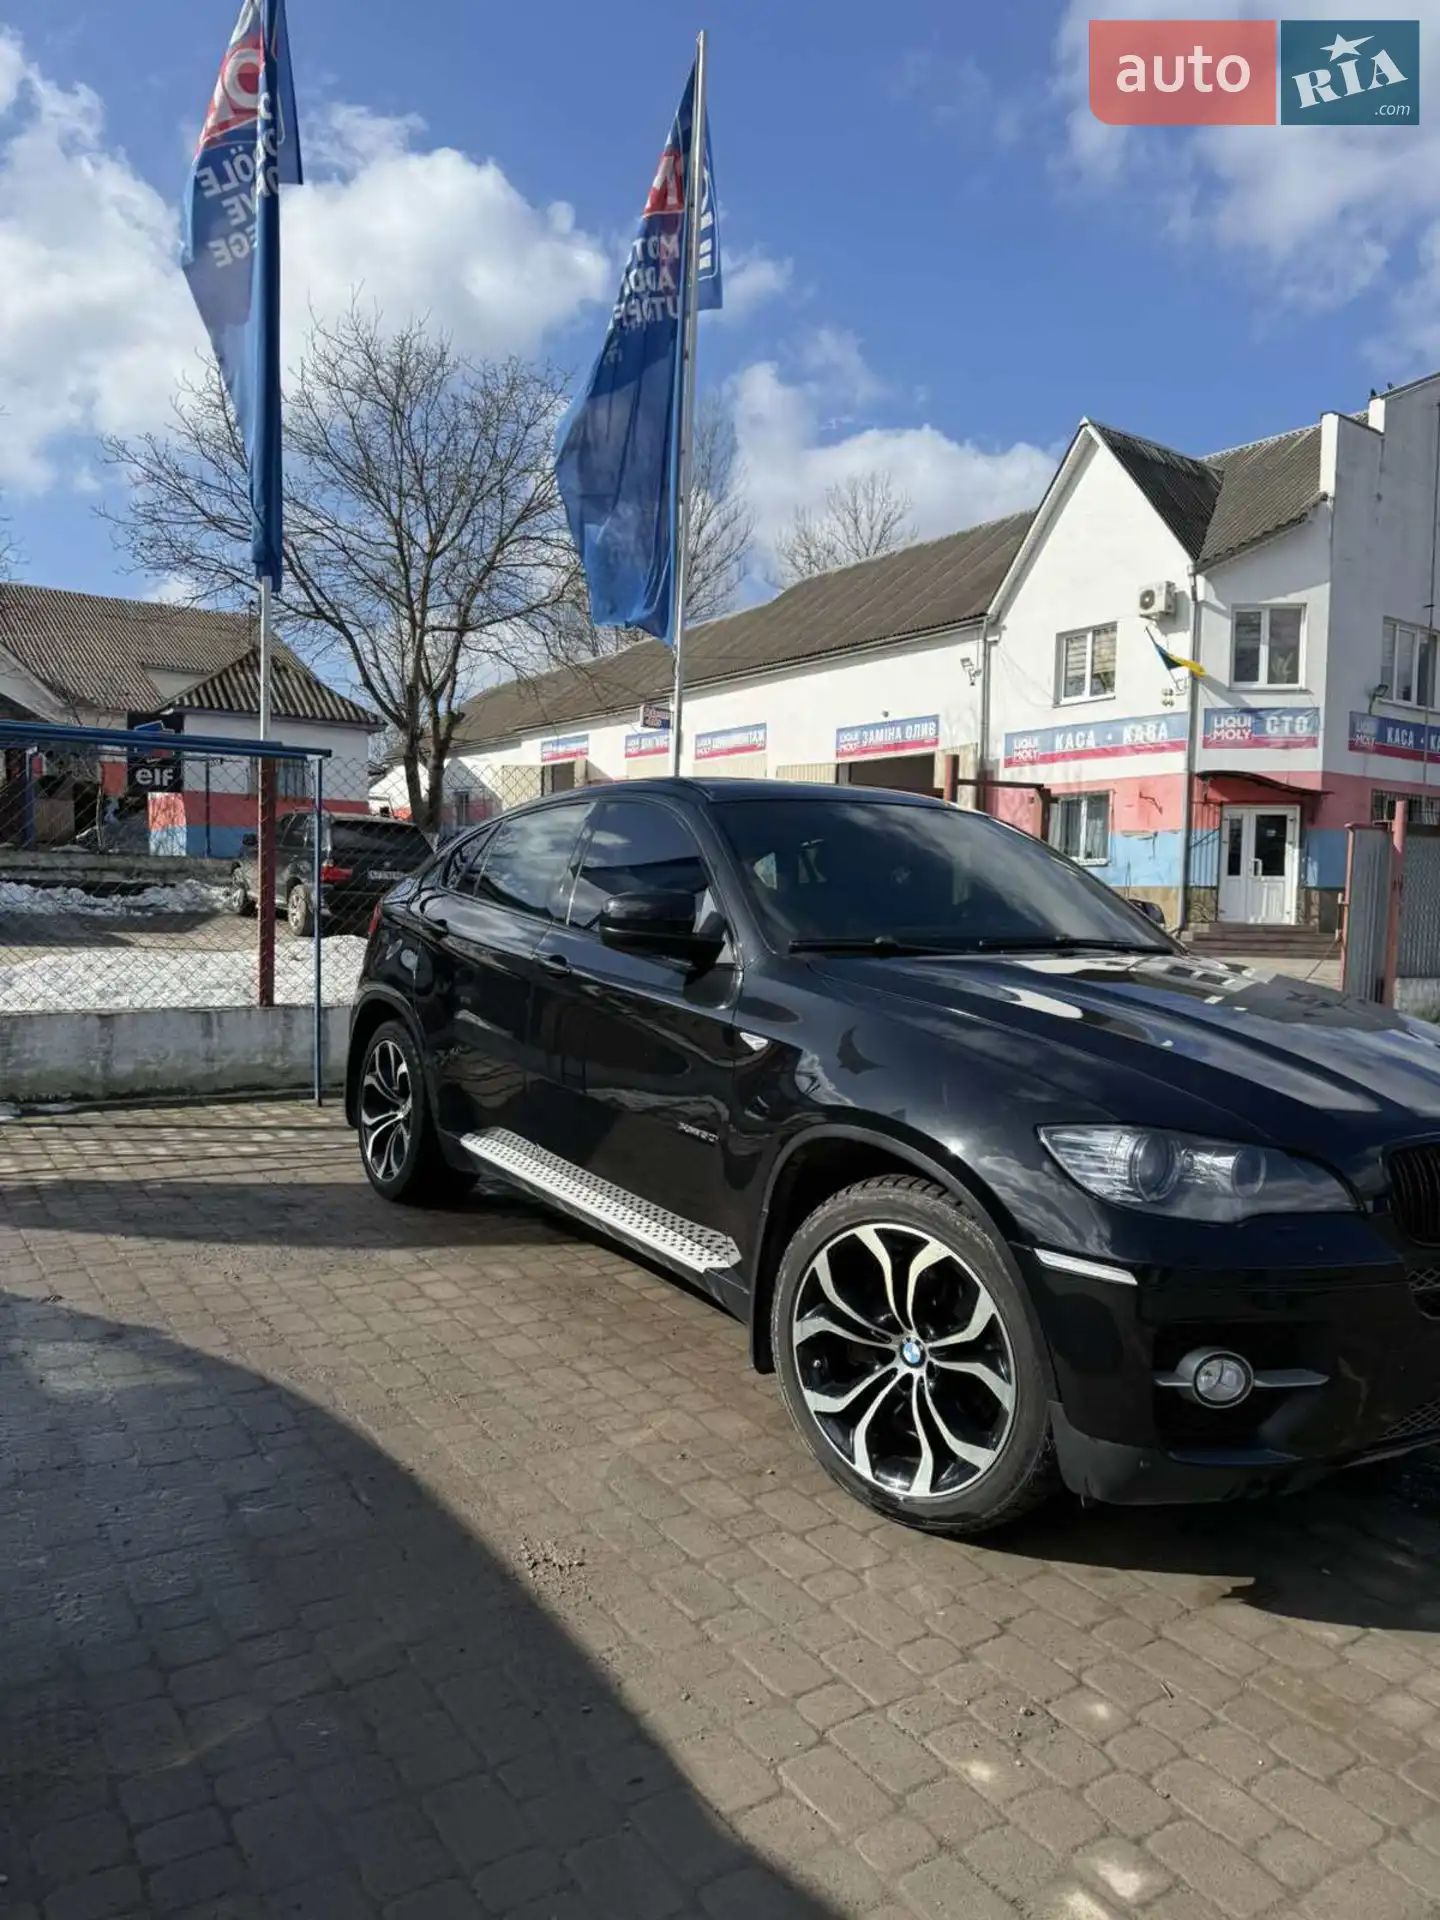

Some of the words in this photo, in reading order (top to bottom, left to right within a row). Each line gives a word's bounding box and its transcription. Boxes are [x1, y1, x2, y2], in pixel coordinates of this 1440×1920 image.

[1213, 715, 1252, 728] LIQUI
[1265, 716, 1308, 734] СТО
[862, 726, 901, 746] ЗАМІНА
[905, 722, 936, 739] ОЛИВ
[1055, 729, 1095, 751] КАСА
[1212, 728, 1252, 741] MOLY
[1386, 727, 1414, 748] КАСА
[136, 768, 174, 786] elf
